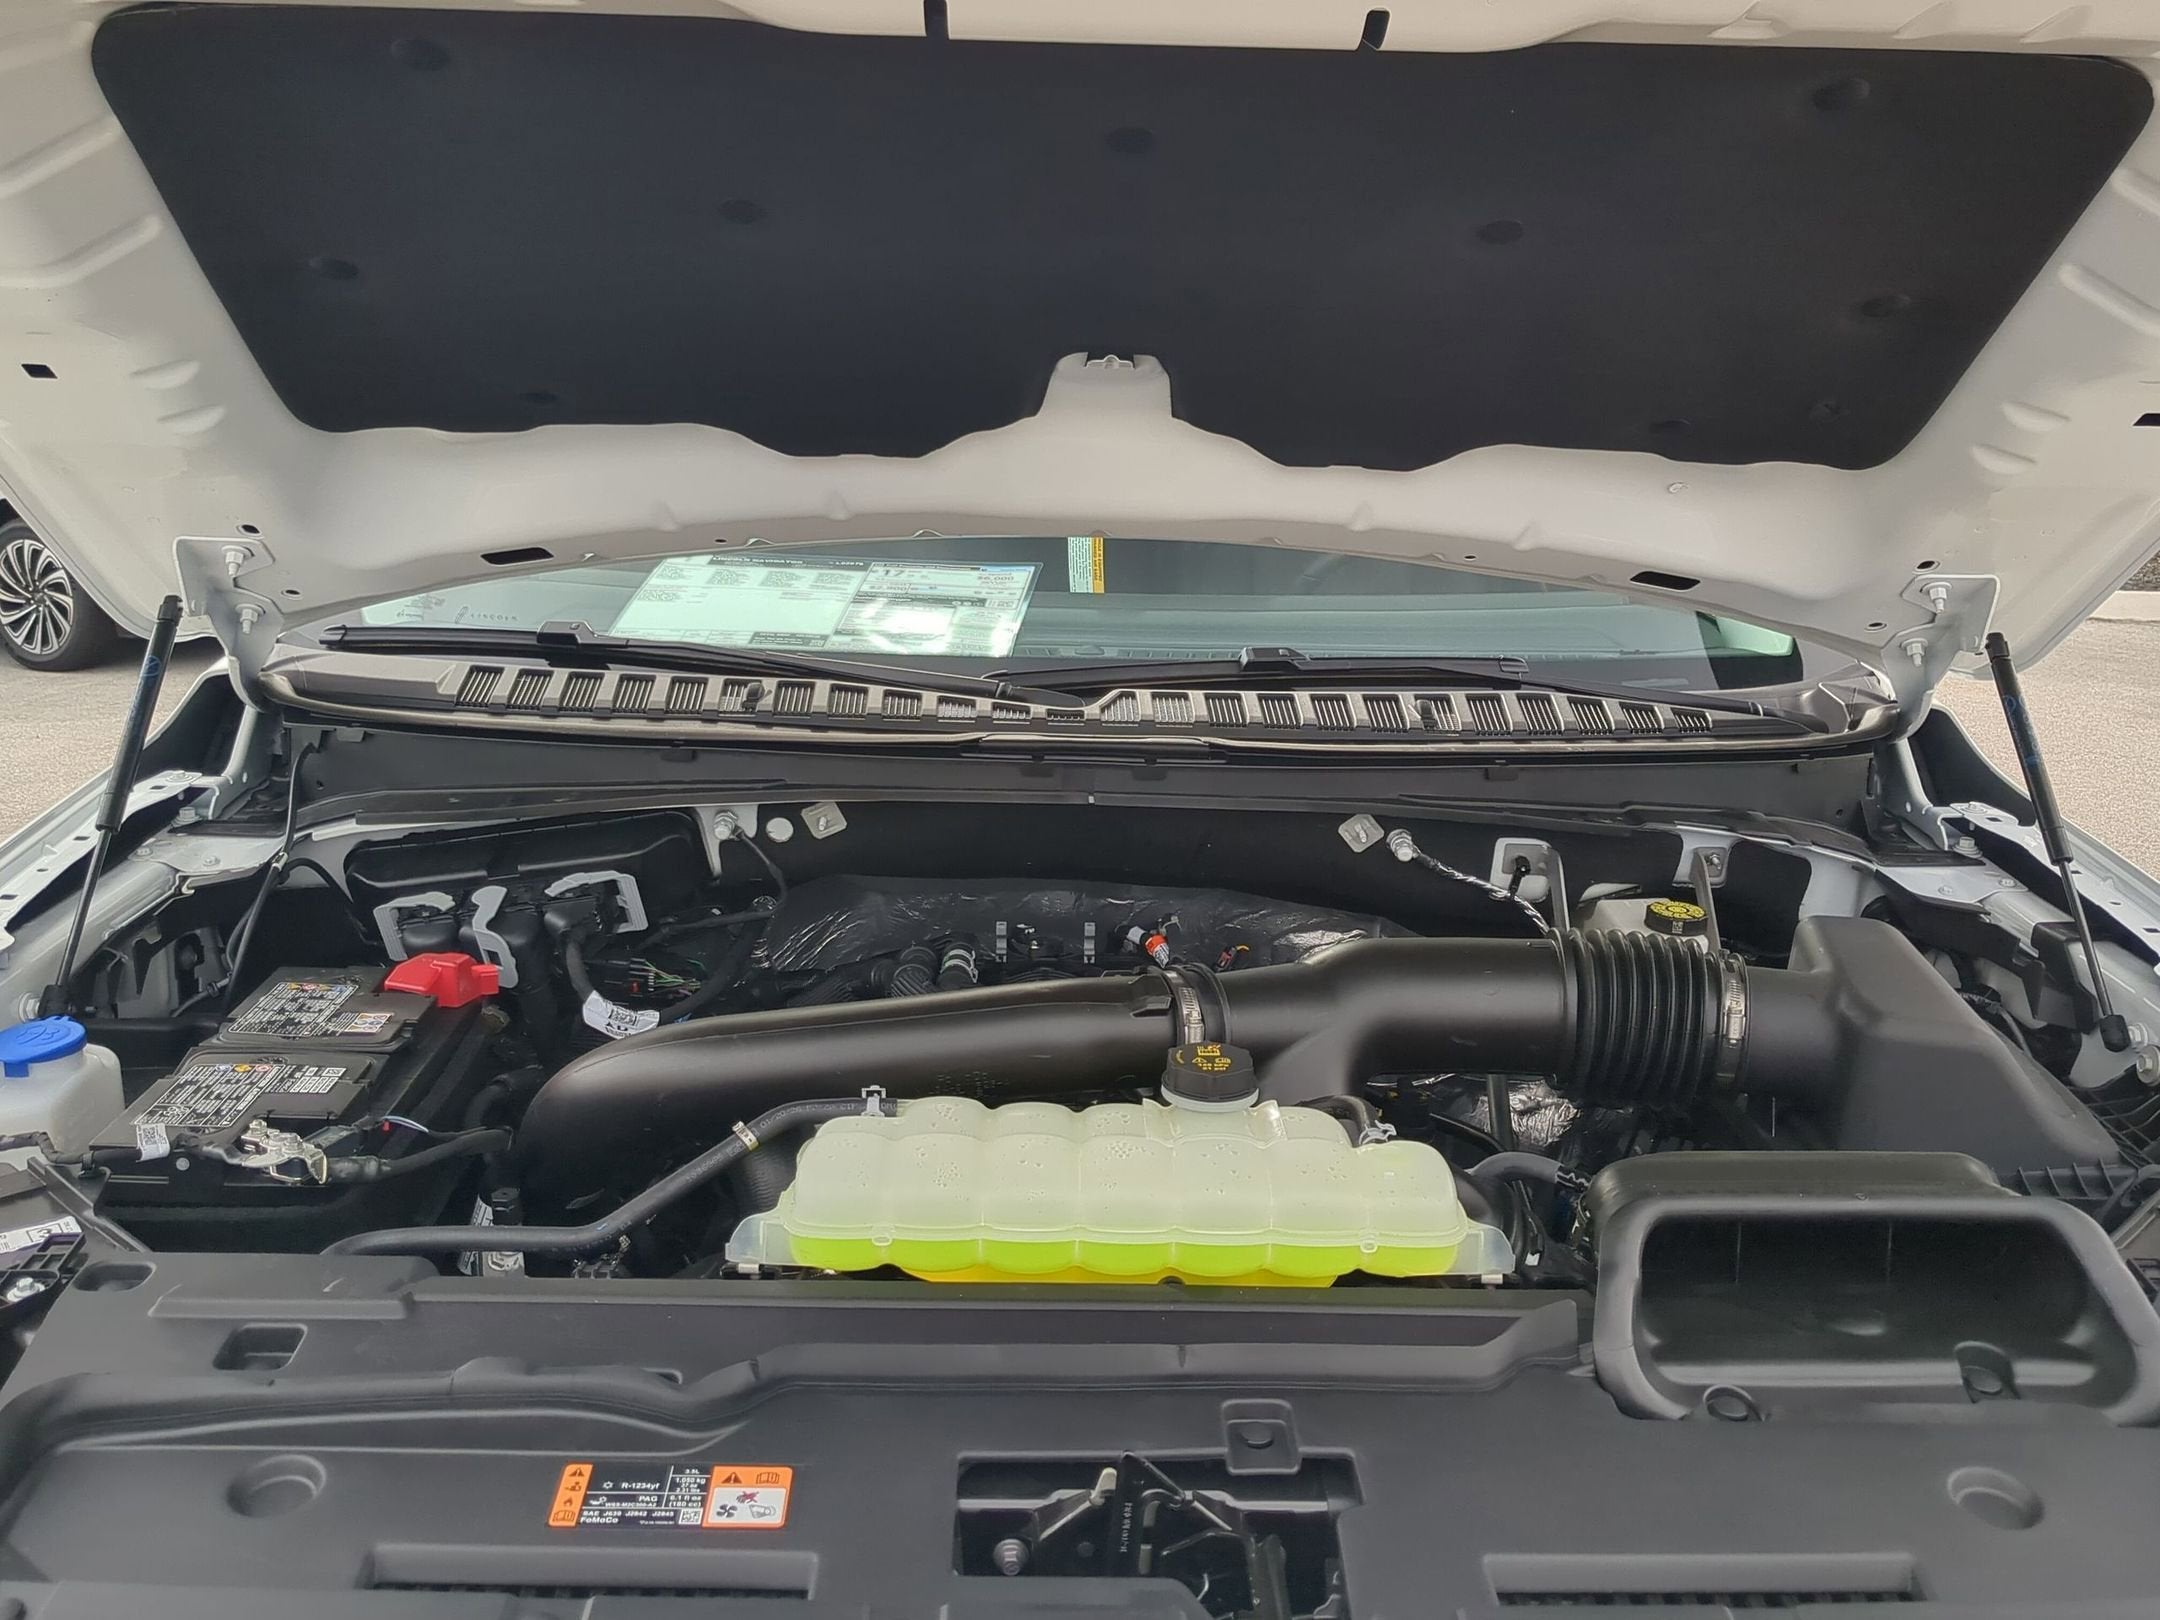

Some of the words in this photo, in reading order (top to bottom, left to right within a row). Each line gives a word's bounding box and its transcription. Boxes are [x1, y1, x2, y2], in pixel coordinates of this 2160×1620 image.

[882, 569, 906, 577] 17
[621, 1482, 660, 1490] R-1234yf
[580, 1516, 619, 1524] FoMoCo
